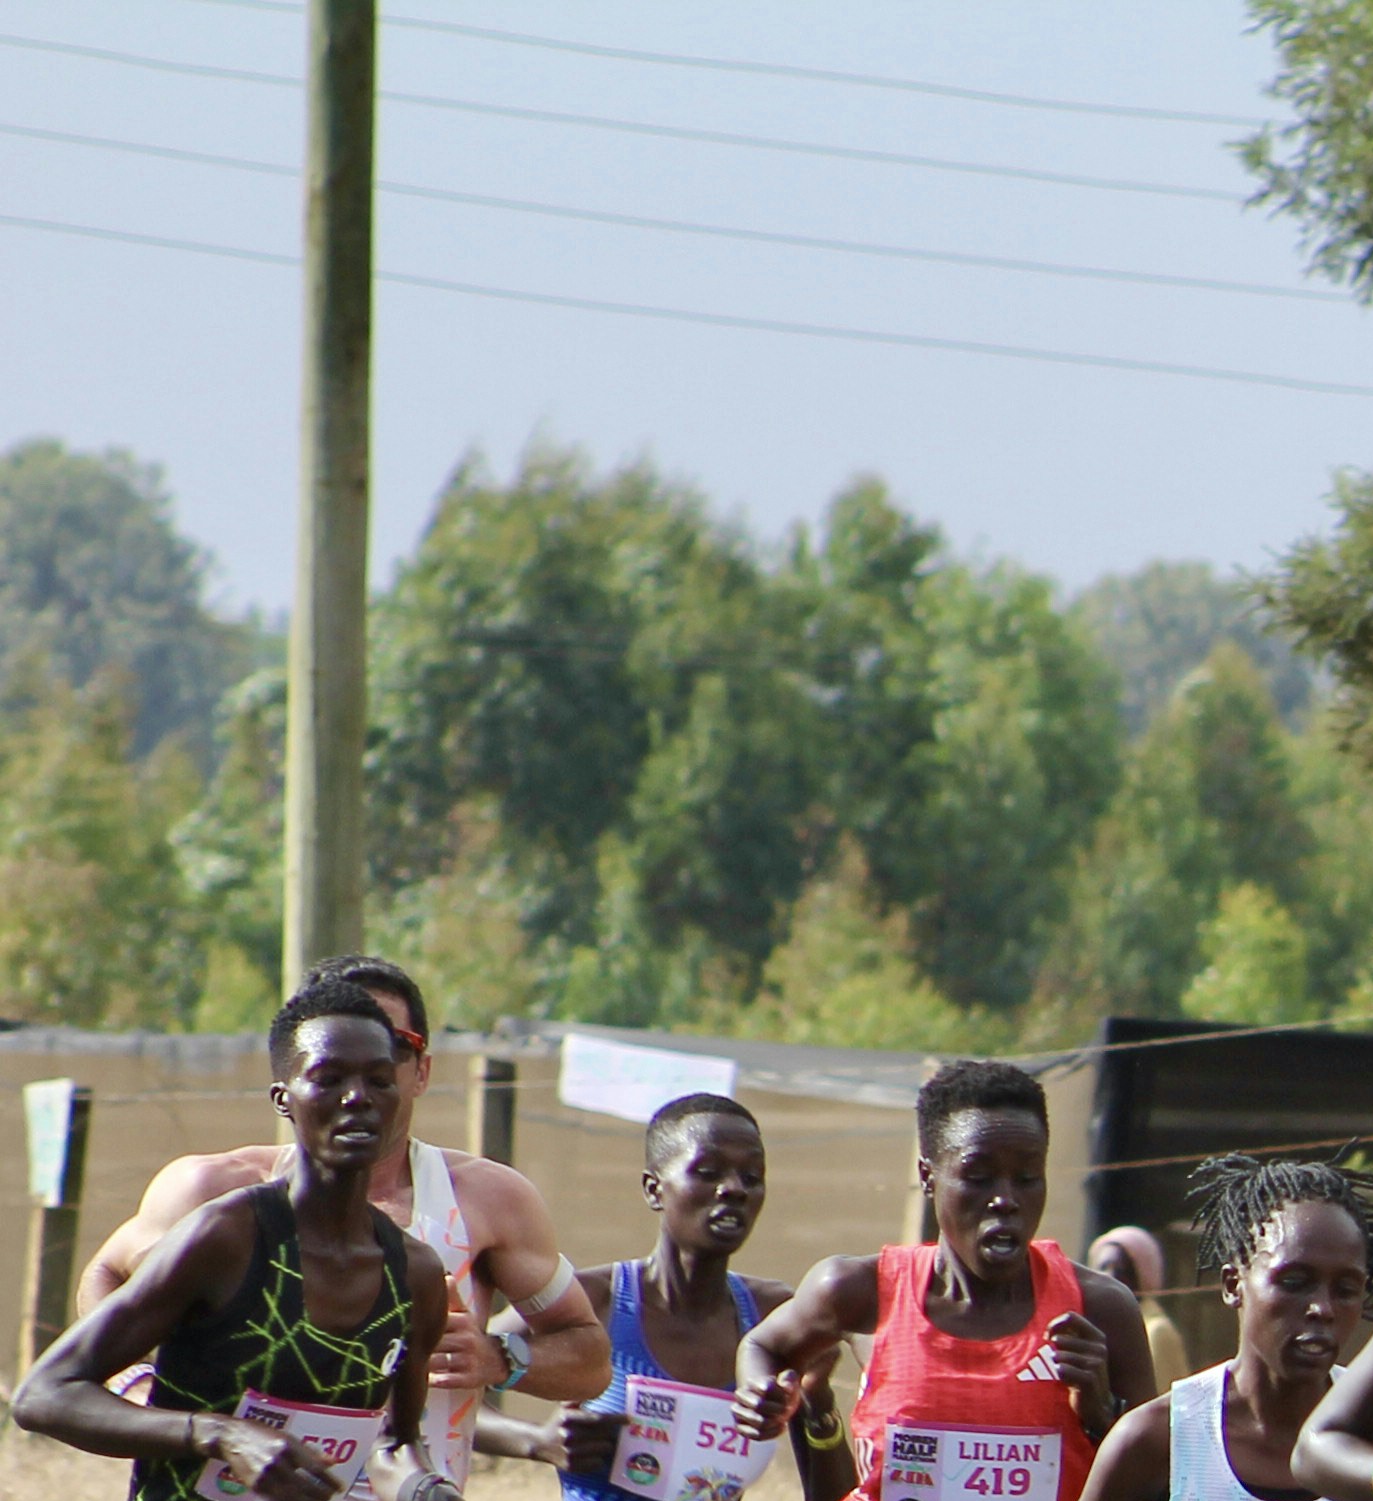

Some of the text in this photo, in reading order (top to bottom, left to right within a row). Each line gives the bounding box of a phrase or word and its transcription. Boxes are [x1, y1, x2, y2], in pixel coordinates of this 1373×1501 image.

[696, 1420, 750, 1457] 521
[892, 1440, 938, 1456] HALF
[958, 1440, 1041, 1462] LILIAN
[963, 1466, 1031, 1496] 419
